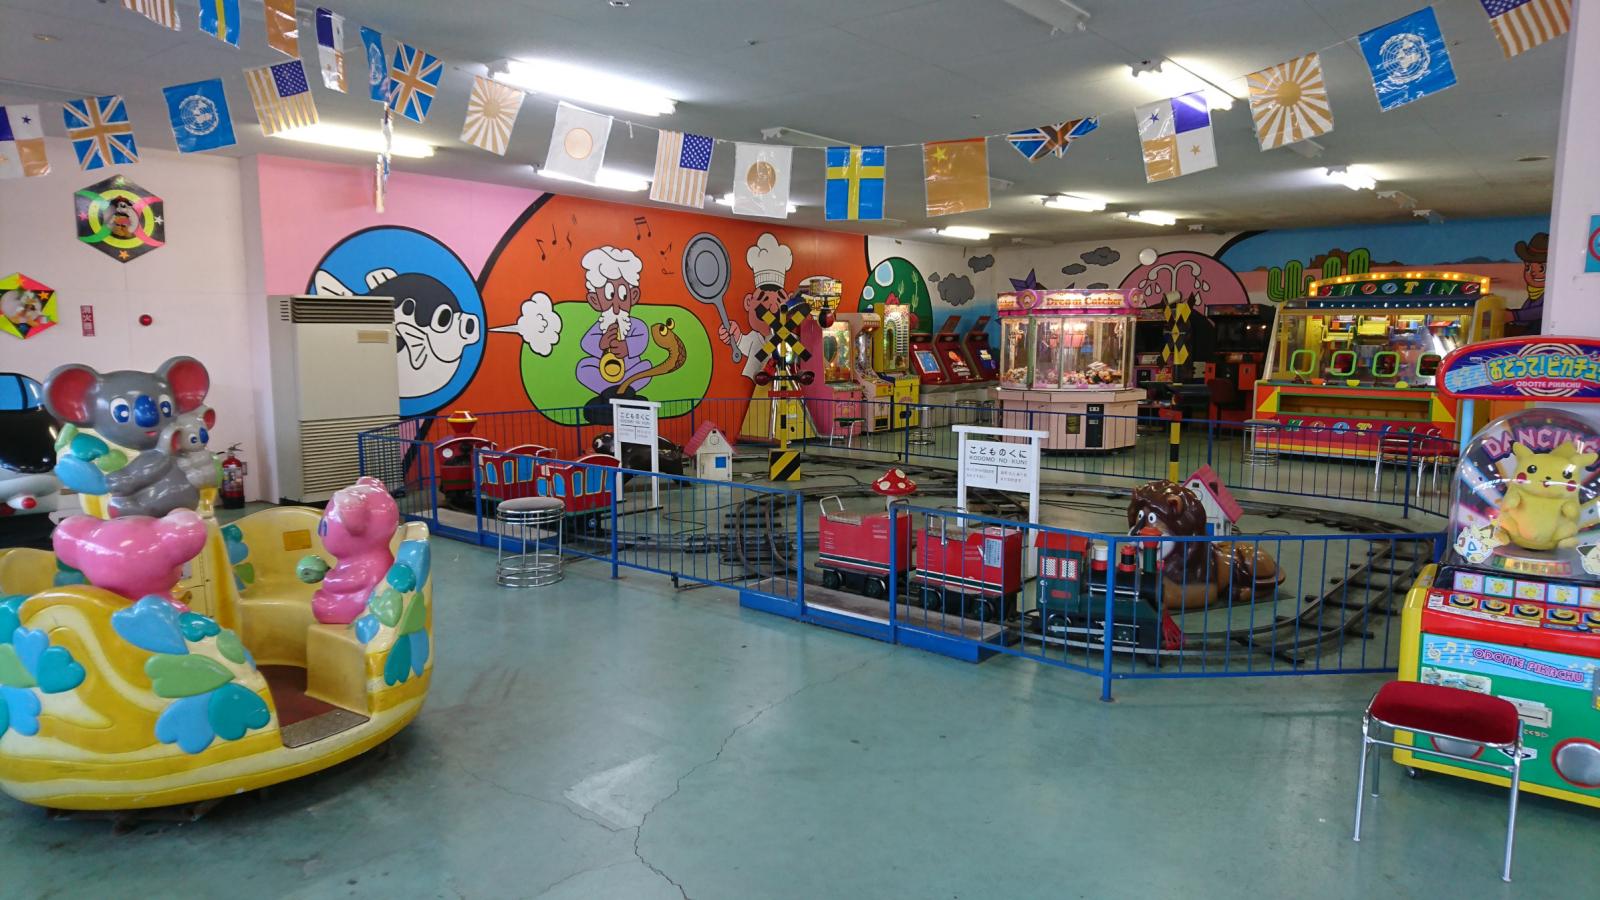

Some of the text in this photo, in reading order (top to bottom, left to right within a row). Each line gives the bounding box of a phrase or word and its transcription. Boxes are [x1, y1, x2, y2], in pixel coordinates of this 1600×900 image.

[1320, 281, 1480, 296] SHOOTING
[1046, 297, 1122, 306] Dream Catcher
[1488, 355, 1600, 380] おどって!ピカチュ
[1515, 380, 1581, 389] ODOTTE PIKACHU
[969, 446, 1028, 459] こどものくに
[1472, 648, 1585, 683] ODOTTE PIKACHU
